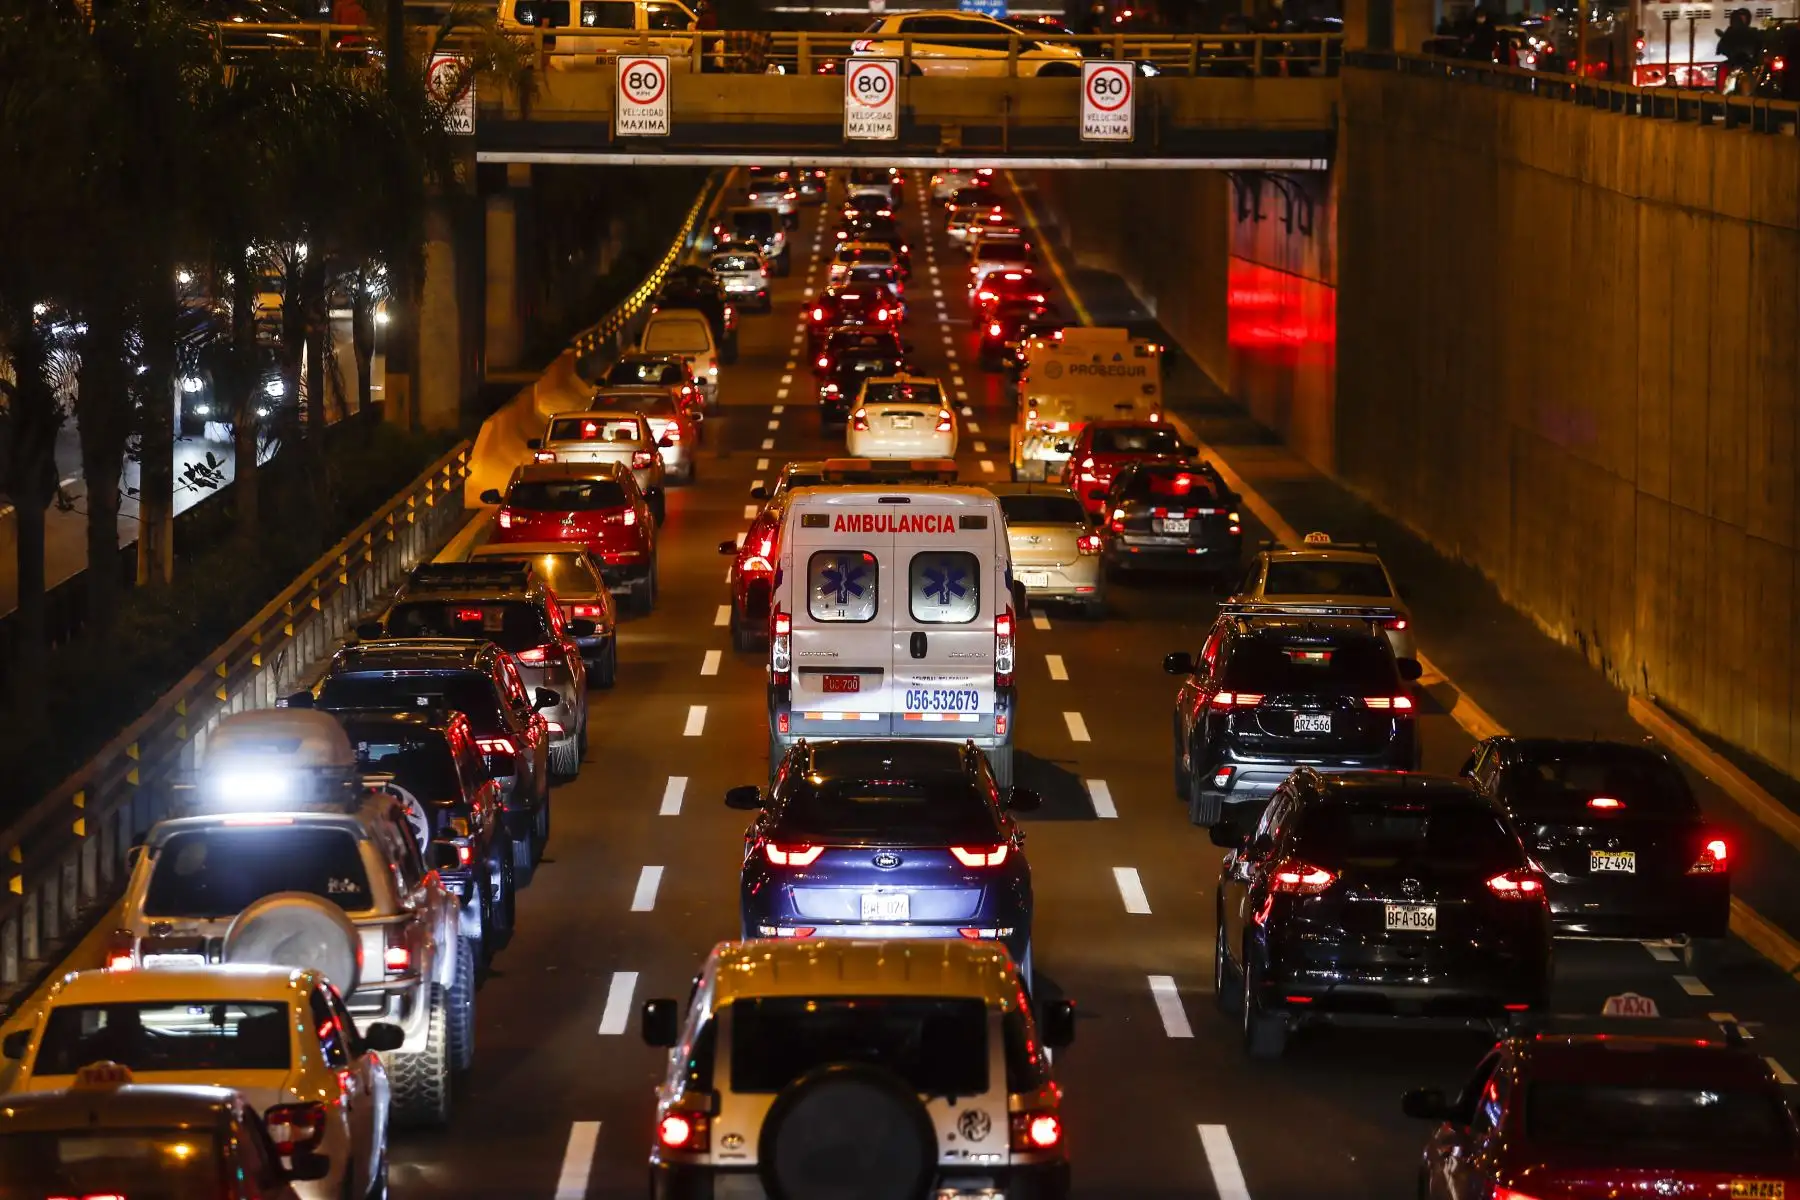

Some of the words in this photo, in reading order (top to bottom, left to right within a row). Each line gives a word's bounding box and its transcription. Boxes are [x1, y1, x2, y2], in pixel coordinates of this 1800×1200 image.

[629, 72, 658, 89] 80
[858, 75, 887, 93] 80
[1094, 77, 1123, 95] 80
[620, 119, 665, 130] MAXIMA
[849, 122, 892, 133] MAXIMA
[1084, 125, 1129, 135] MAXIMA
[1069, 364, 1146, 378] PROSEGUR
[834, 514, 955, 533] AMBULANCIA
[906, 689, 979, 711] 056-532679
[1295, 719, 1330, 732] ARZ-566
[1591, 856, 1634, 871] BFZ-494
[1388, 911, 1435, 927] BFA-036
[1611, 997, 1653, 1016] TAXI
